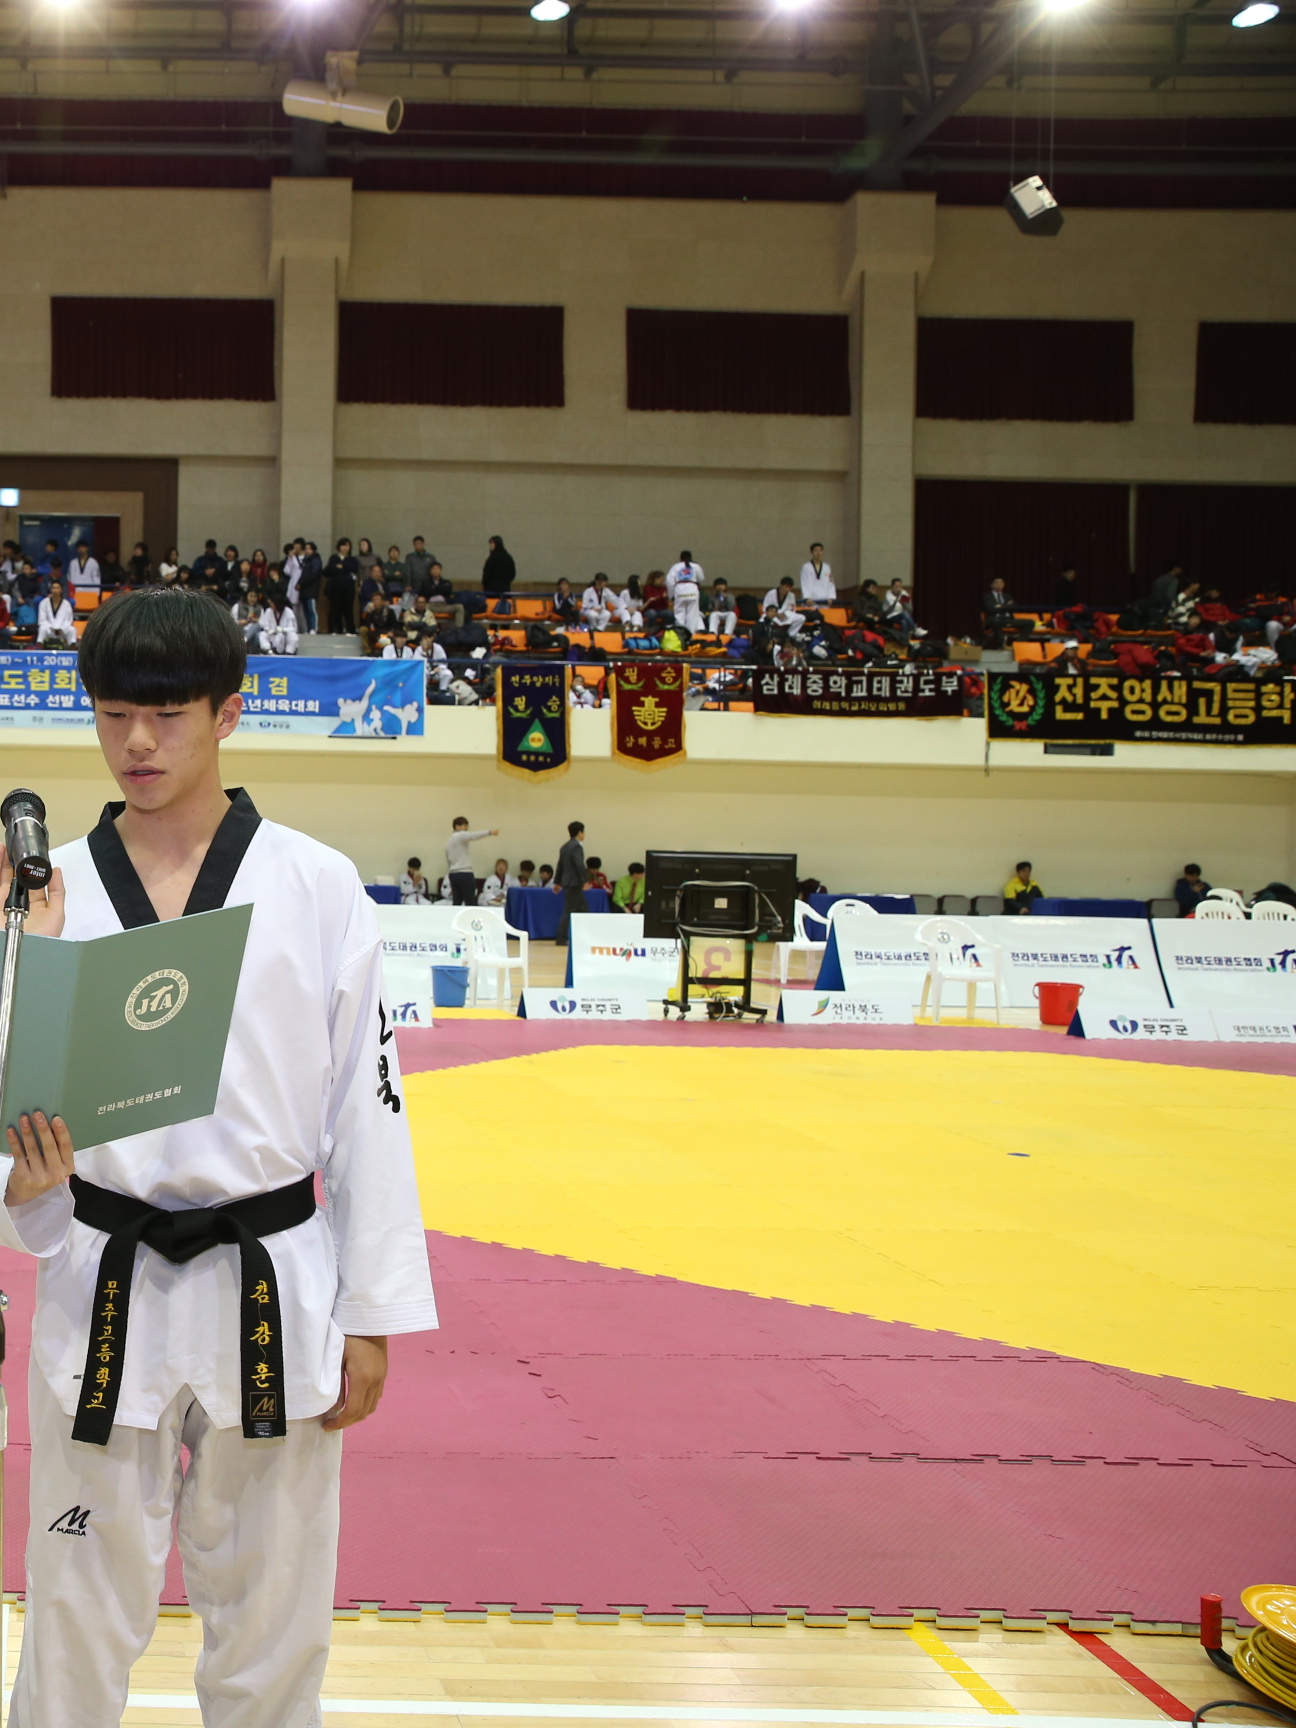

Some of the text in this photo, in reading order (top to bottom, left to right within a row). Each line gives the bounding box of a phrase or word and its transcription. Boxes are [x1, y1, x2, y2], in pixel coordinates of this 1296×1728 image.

[268, 676, 288, 696] 겸
[760, 673, 959, 697] 삼례중학교태권도부
[46, 695, 75, 708] 선발
[1102, 946, 1140, 969] JTA
[135, 984, 174, 1016] JTA
[581, 1004, 622, 1015] 무주군
[832, 1003, 883, 1016] 전라북도
[1143, 1024, 1188, 1036] 무주군
[97, 1085, 182, 1115] 전라북도태권도협회
